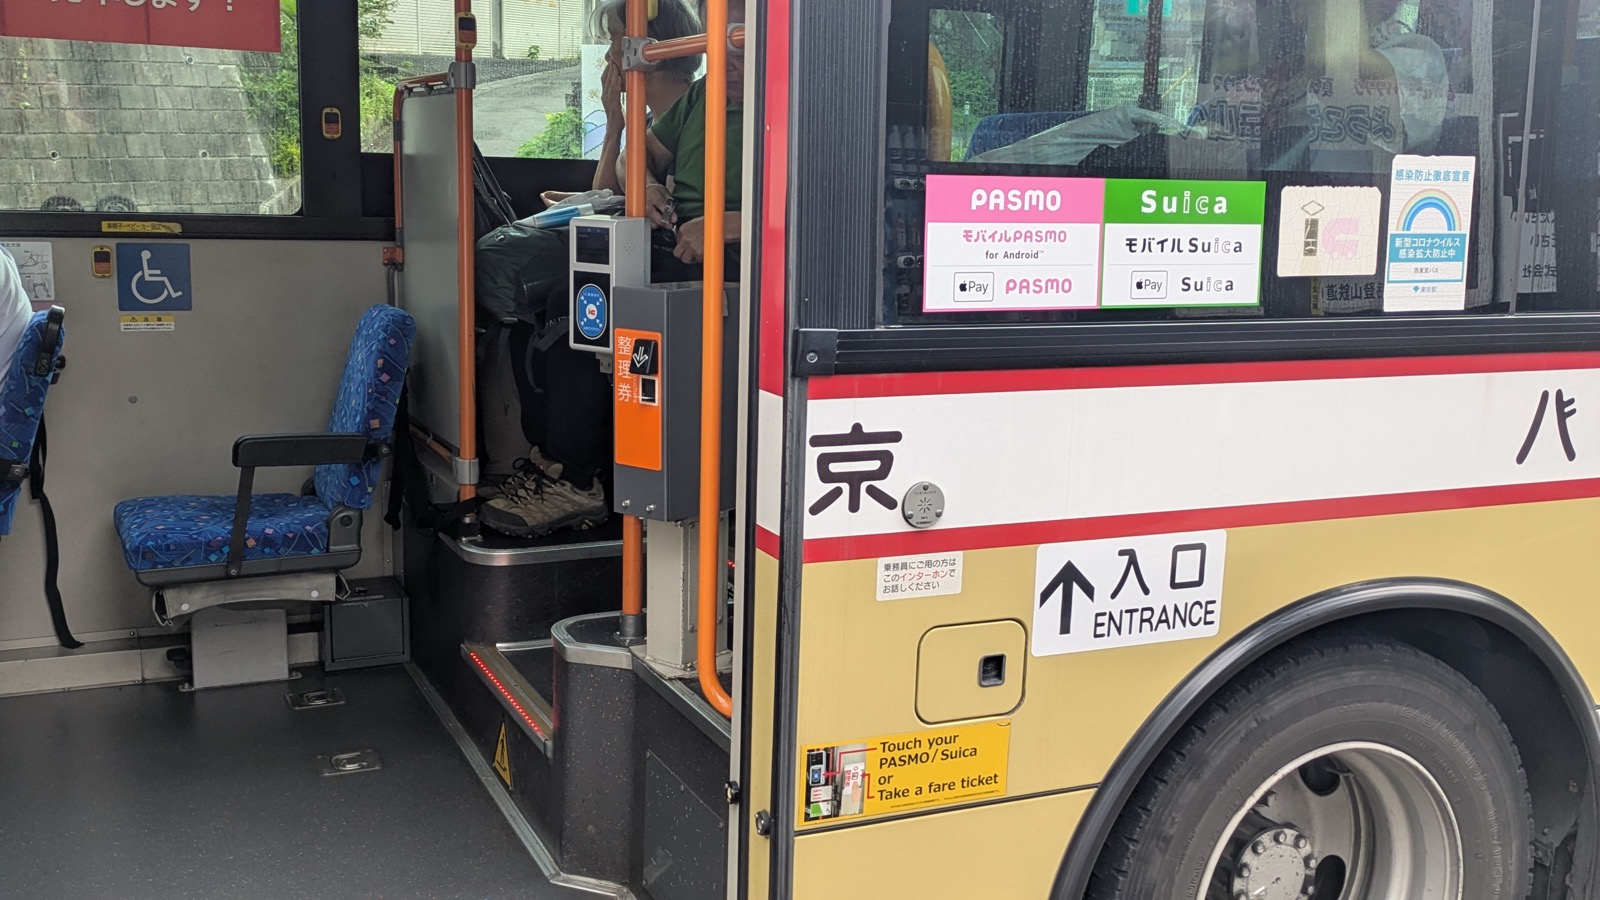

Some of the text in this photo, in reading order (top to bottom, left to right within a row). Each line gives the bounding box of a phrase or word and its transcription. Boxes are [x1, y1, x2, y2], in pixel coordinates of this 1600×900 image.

[1395, 168, 1471, 182] 感染防止徹底宣言
[970, 188, 1062, 212] PASMO
[1141, 189, 1228, 214] Suica
[962, 229, 1067, 243] モバイルPASMO
[1394, 237, 1461, 248] 新型コロナウイルス
[985, 250, 998, 260] for
[1398, 248, 1456, 259] 感染拡大防止中
[968, 278, 1073, 295] Pay PASMO
[1144, 277, 1235, 292] Pay Suica
[617, 335, 632, 402] 整理券
[808, 422, 903, 516] 京
[884, 557, 957, 573] 乗務員にご用の方は
[1110, 542, 1207, 600] 入口
[883, 569, 956, 583] このインターホンで
[882, 581, 940, 594] お話しください
[1093, 600, 1217, 639] ENTRANCE
[879, 733, 960, 753] Touch your
[878, 774, 894, 786] or
[878, 773, 999, 802] Take a fare ticket
